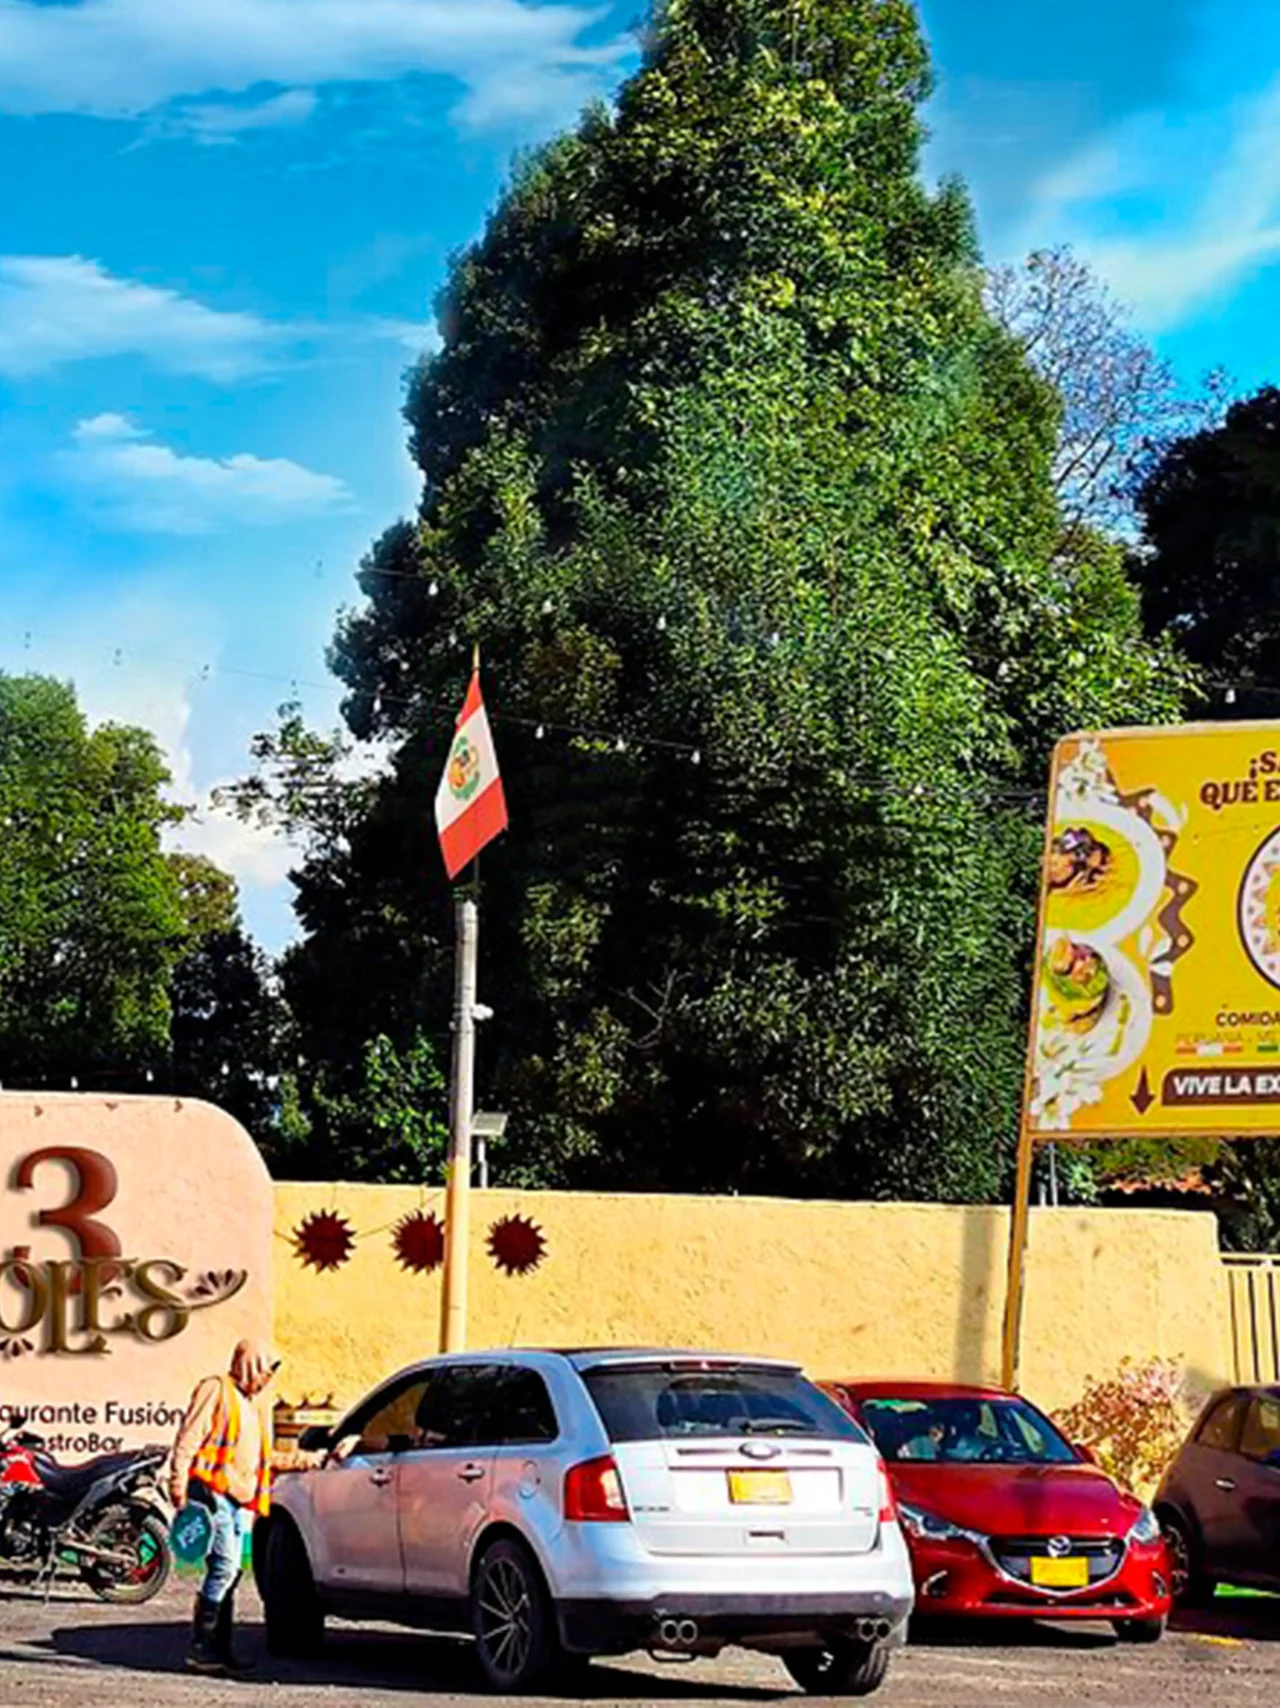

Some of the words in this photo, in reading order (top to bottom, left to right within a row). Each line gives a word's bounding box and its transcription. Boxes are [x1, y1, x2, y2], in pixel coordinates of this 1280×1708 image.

[1173, 1076, 1222, 1096] VIVE
[1225, 1075, 1251, 1094] LA
[11, 1146, 122, 1294] 3
[105, 1401, 185, 1426] Fusión
